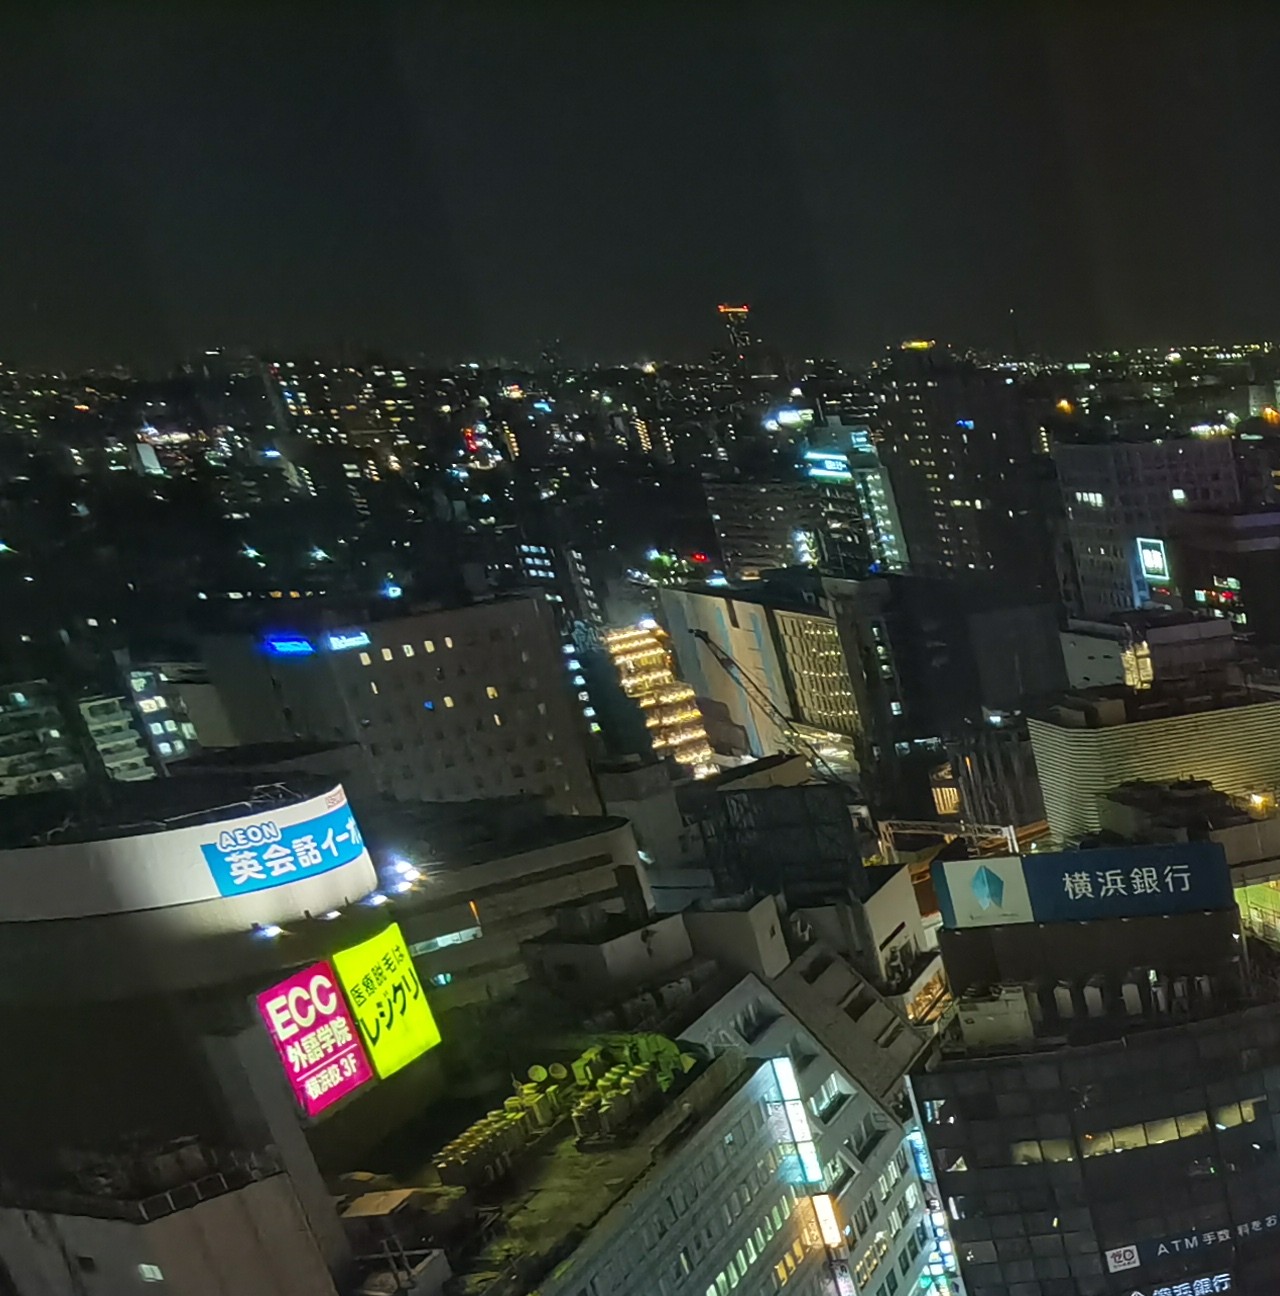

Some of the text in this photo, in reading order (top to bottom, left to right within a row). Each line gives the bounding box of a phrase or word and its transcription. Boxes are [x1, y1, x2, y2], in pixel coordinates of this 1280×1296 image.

[219, 822, 279, 850] AEON
[1062, 864, 1191, 899] 横浜銀行
[350, 945, 404, 1006] 医療脱毛は
[266, 975, 337, 1041] ECC
[360, 967, 419, 1046] レジクリ
[286, 1016, 352, 1072] 外語学院
[305, 1053, 357, 1100] 横浜校 3F
